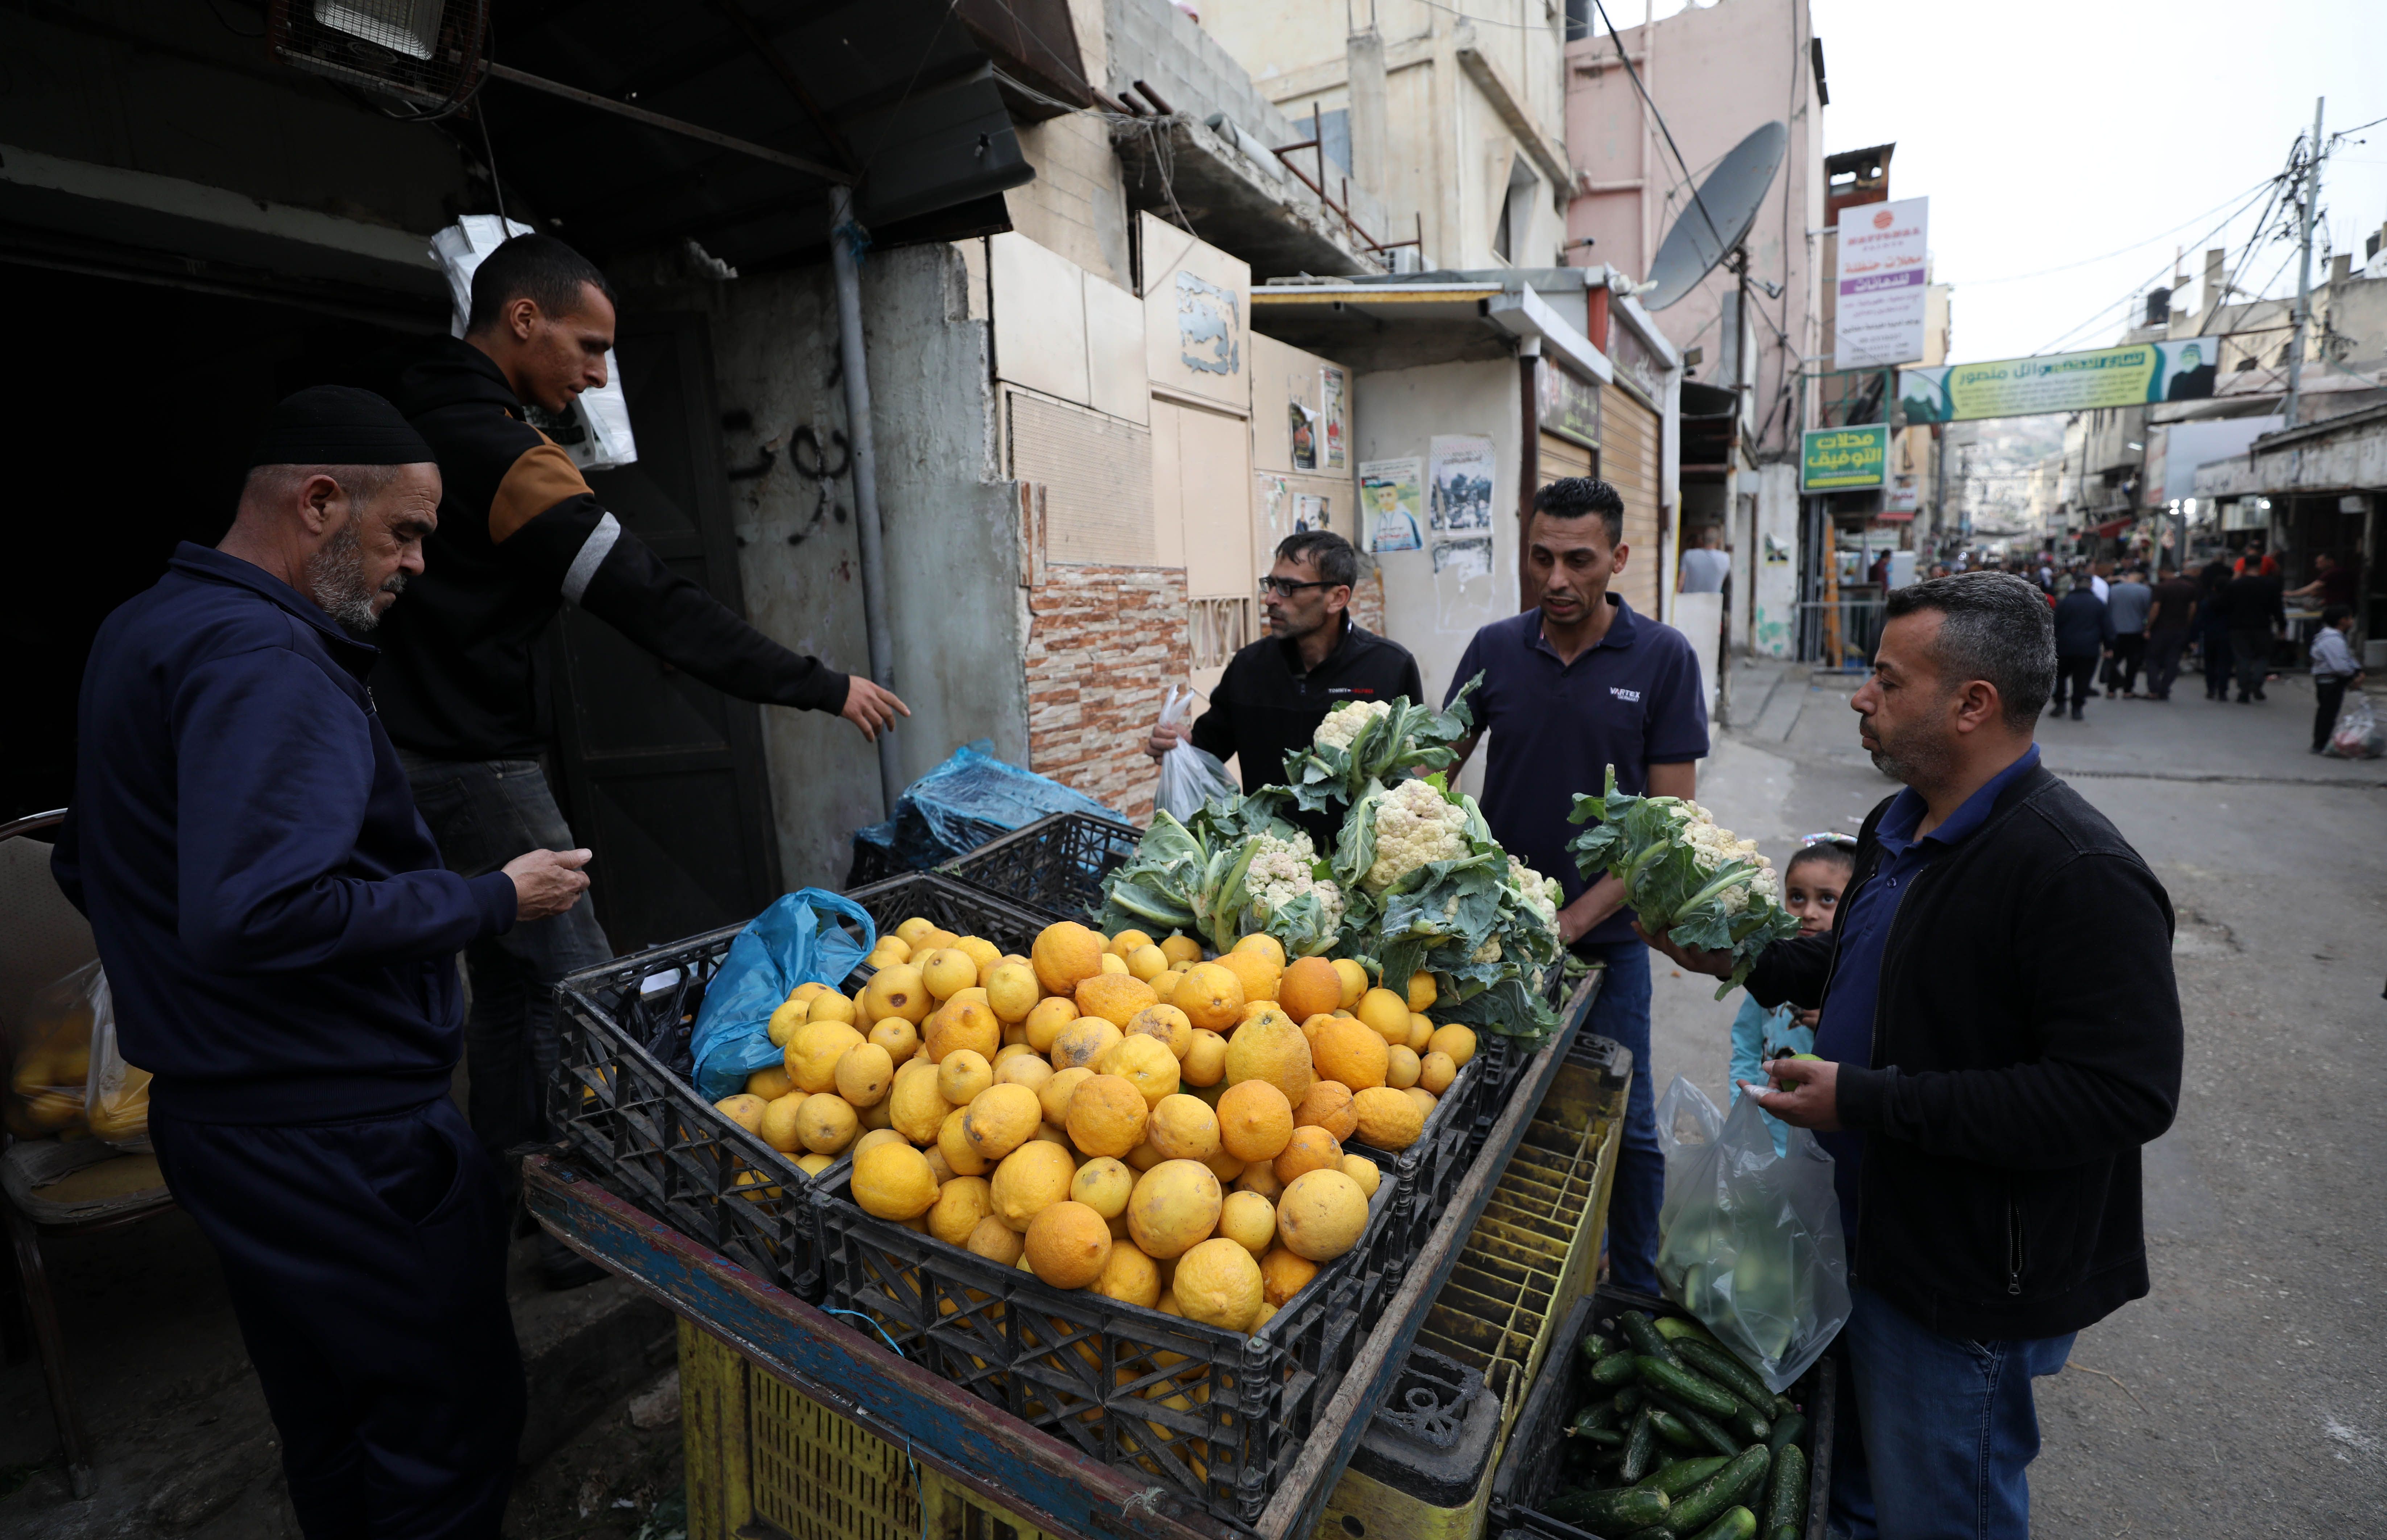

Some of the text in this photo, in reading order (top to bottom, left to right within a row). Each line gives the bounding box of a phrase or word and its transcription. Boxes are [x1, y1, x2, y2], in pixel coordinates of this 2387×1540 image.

[1959, 366, 2009, 385] منصور
[1816, 432, 1875, 449] محلات
[1807, 447, 1882, 469] التوفيق
[1610, 687, 1641, 698] VARTEX
